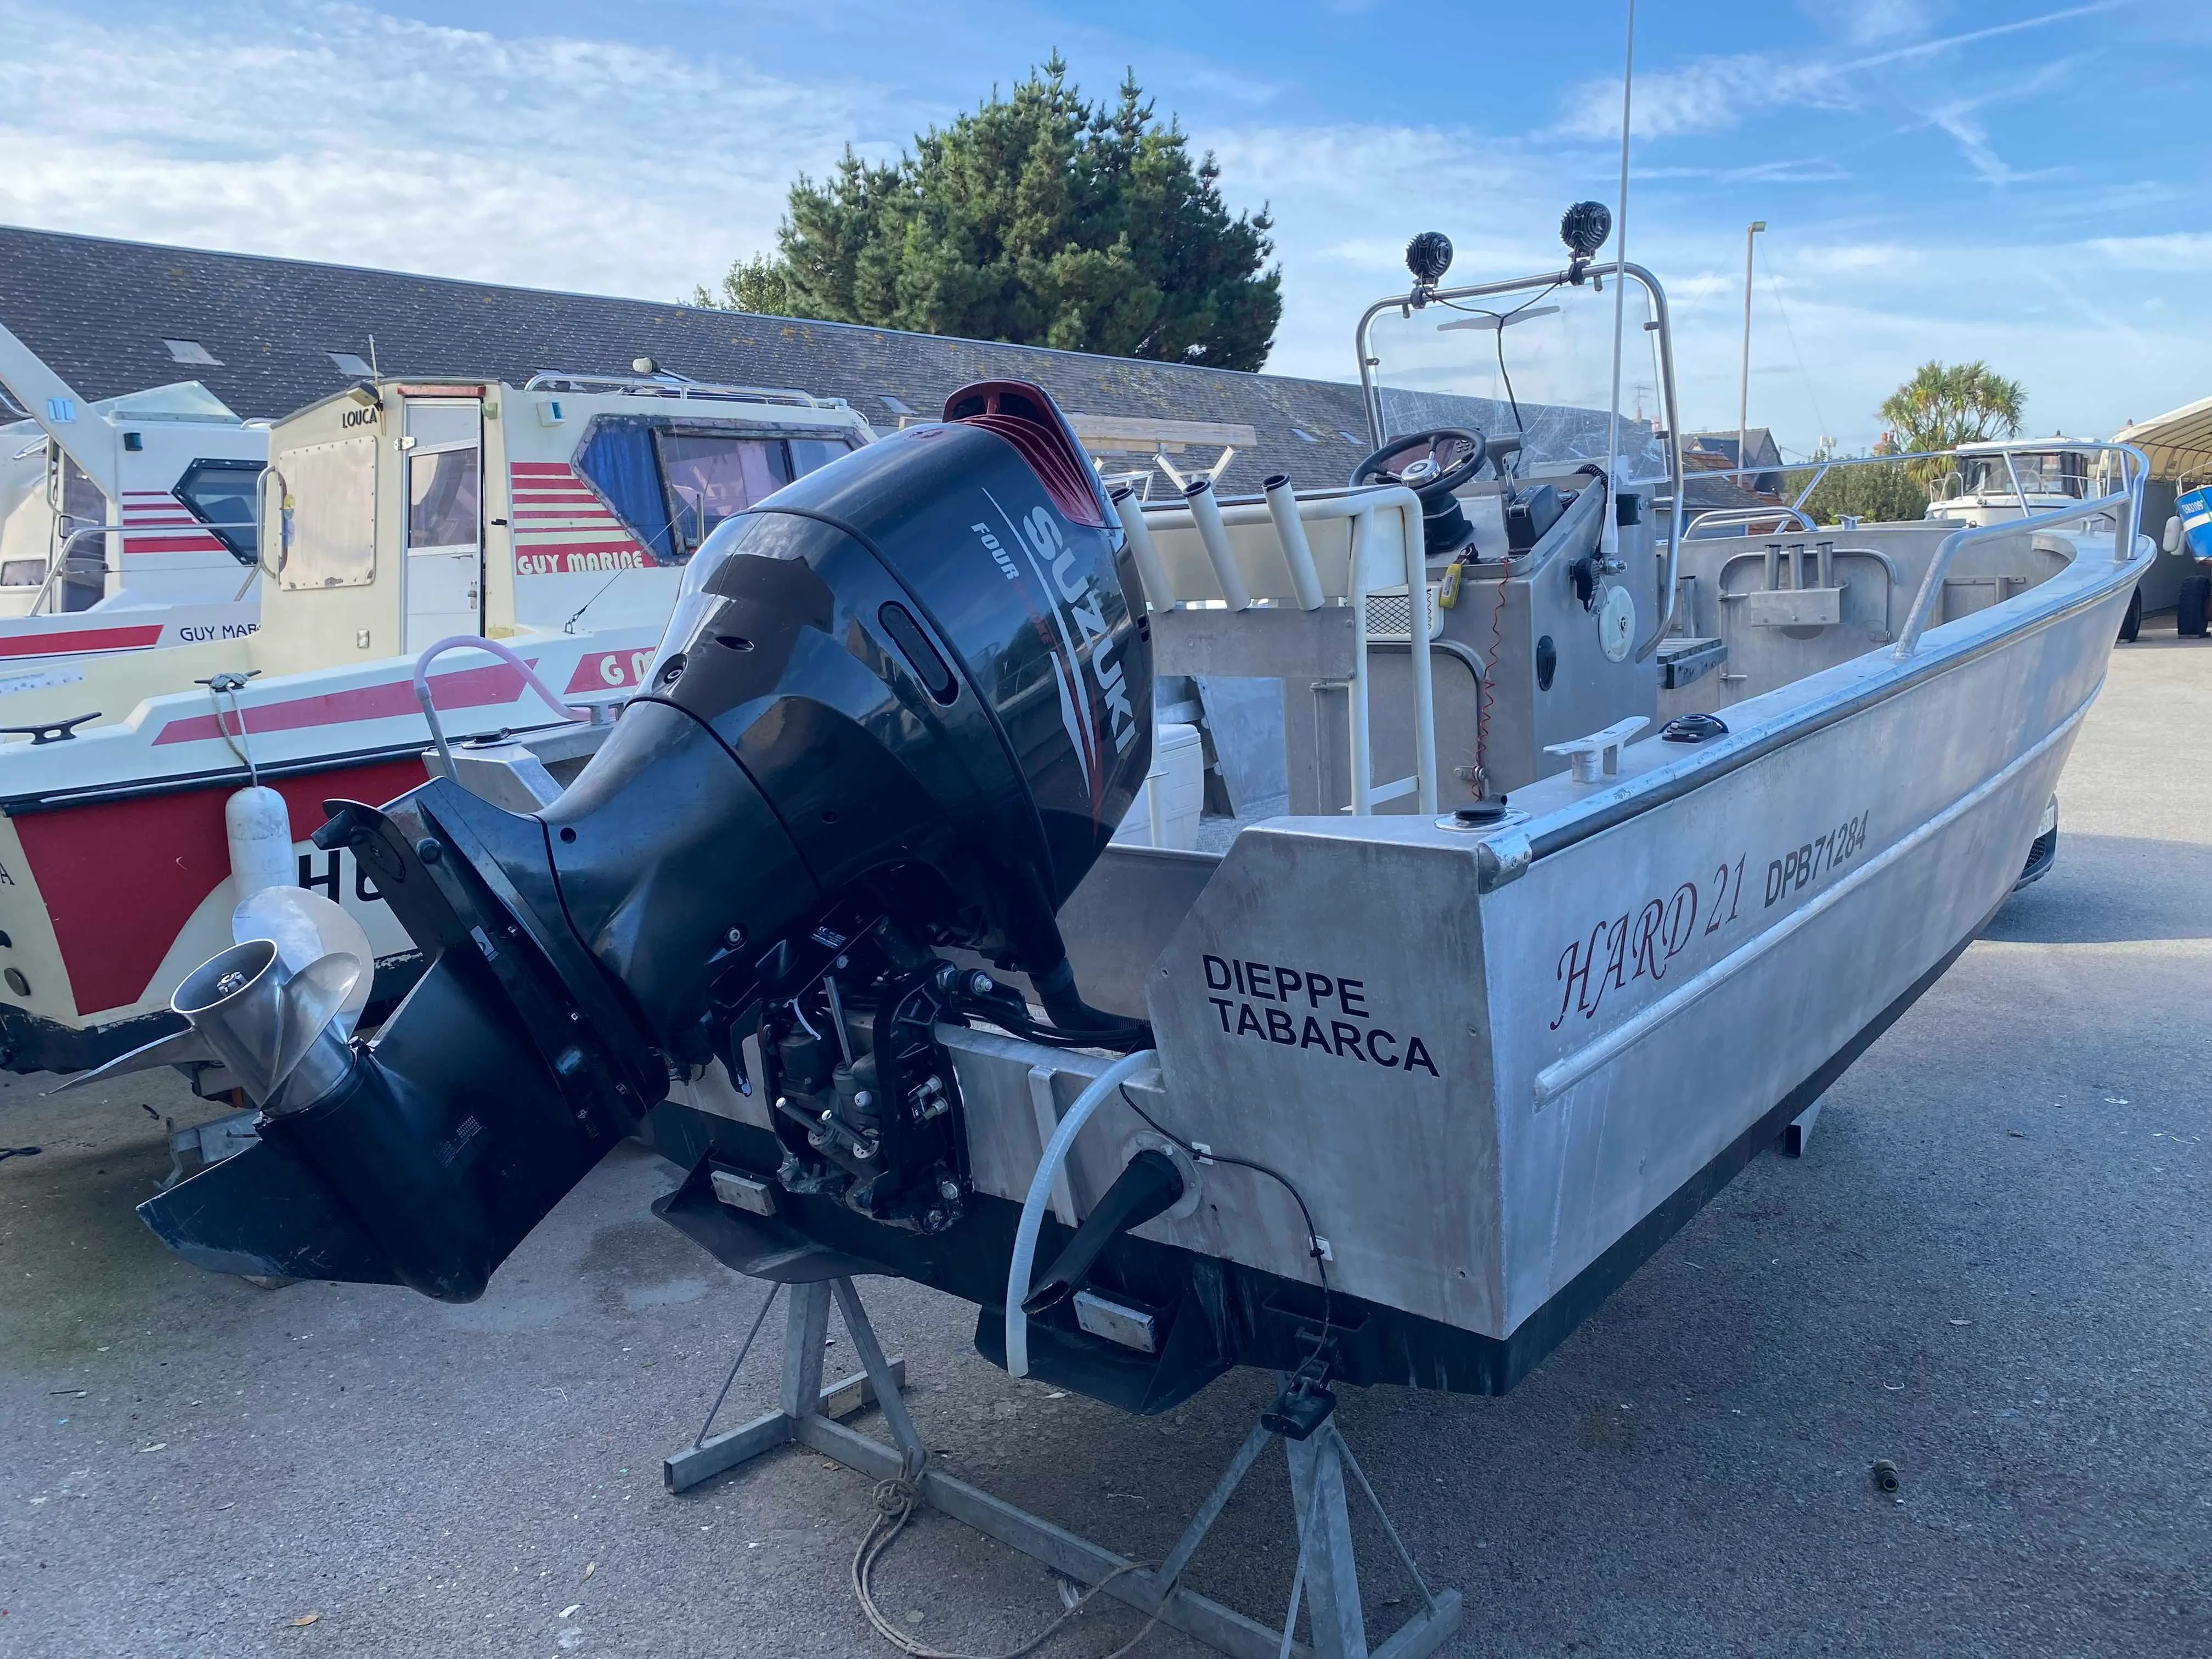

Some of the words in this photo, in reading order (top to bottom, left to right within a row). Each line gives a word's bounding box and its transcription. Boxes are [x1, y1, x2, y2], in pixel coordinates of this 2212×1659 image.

[342, 408, 377, 428] LOUCA
[517, 554, 560, 575] GUY
[567, 550, 644, 573] MARINE
[970, 522, 1019, 580] FOUR
[180, 626, 215, 641] GUY
[222, 623, 261, 639] MAR
[1023, 506, 1136, 754] SUZUKI
[1764, 809, 1869, 909] DPB71284
[1550, 882, 1698, 1031] HARD
[1704, 851, 1746, 936] 21
[1202, 953, 1370, 1019] DIEPPE
[1208, 996, 1441, 1078] TABARCA
